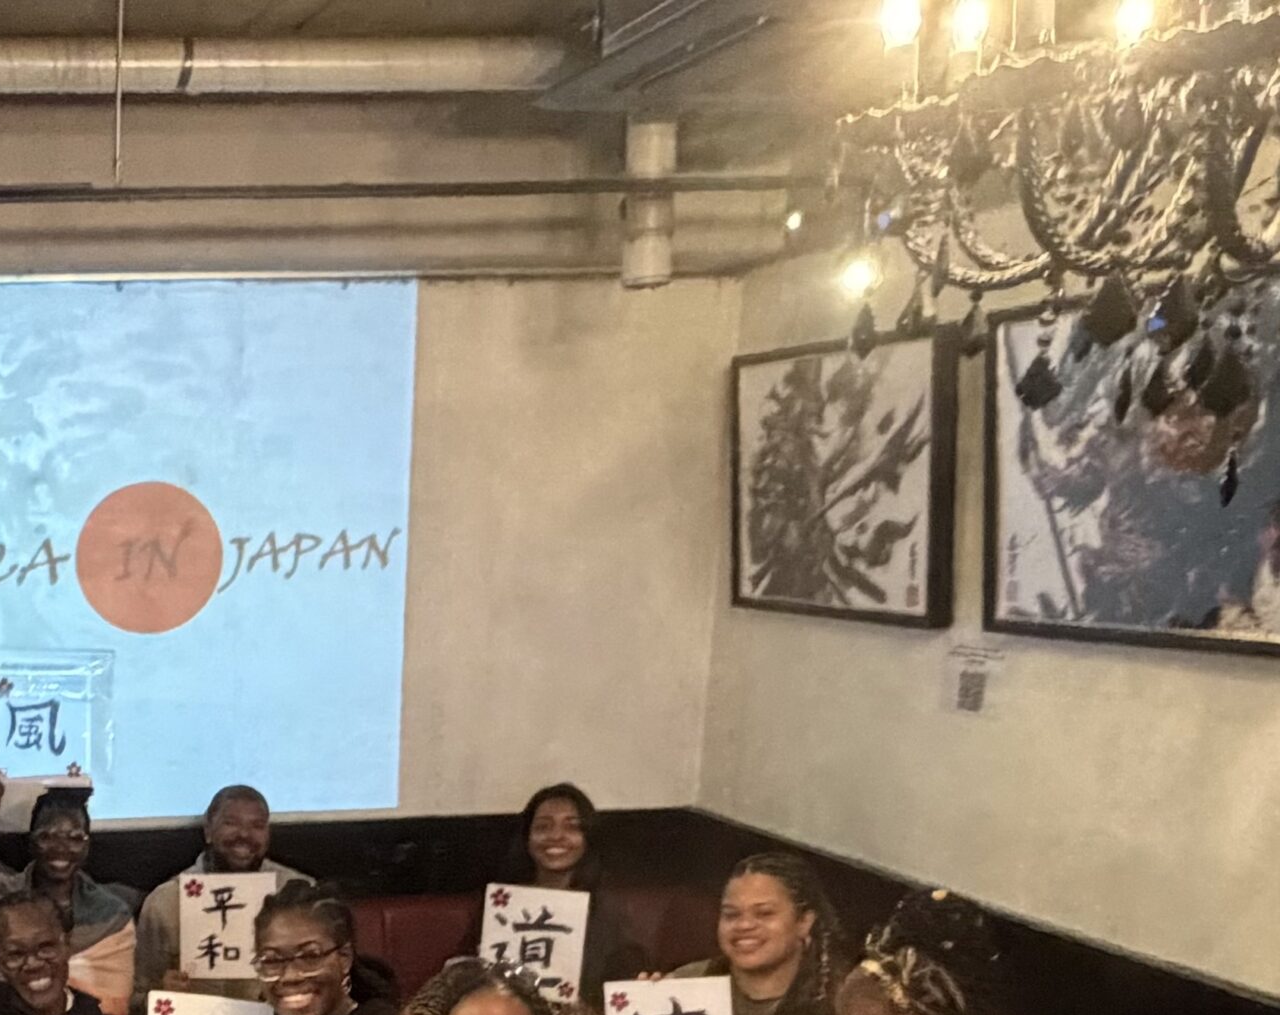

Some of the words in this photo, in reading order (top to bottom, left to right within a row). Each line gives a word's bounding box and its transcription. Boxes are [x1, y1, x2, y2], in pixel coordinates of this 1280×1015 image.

[113, 518, 194, 584] IN
[217, 526, 403, 594] JAPAN
[5, 698, 67, 757] 風
[193, 886, 248, 971] 平和
[489, 904, 574, 989] 道
